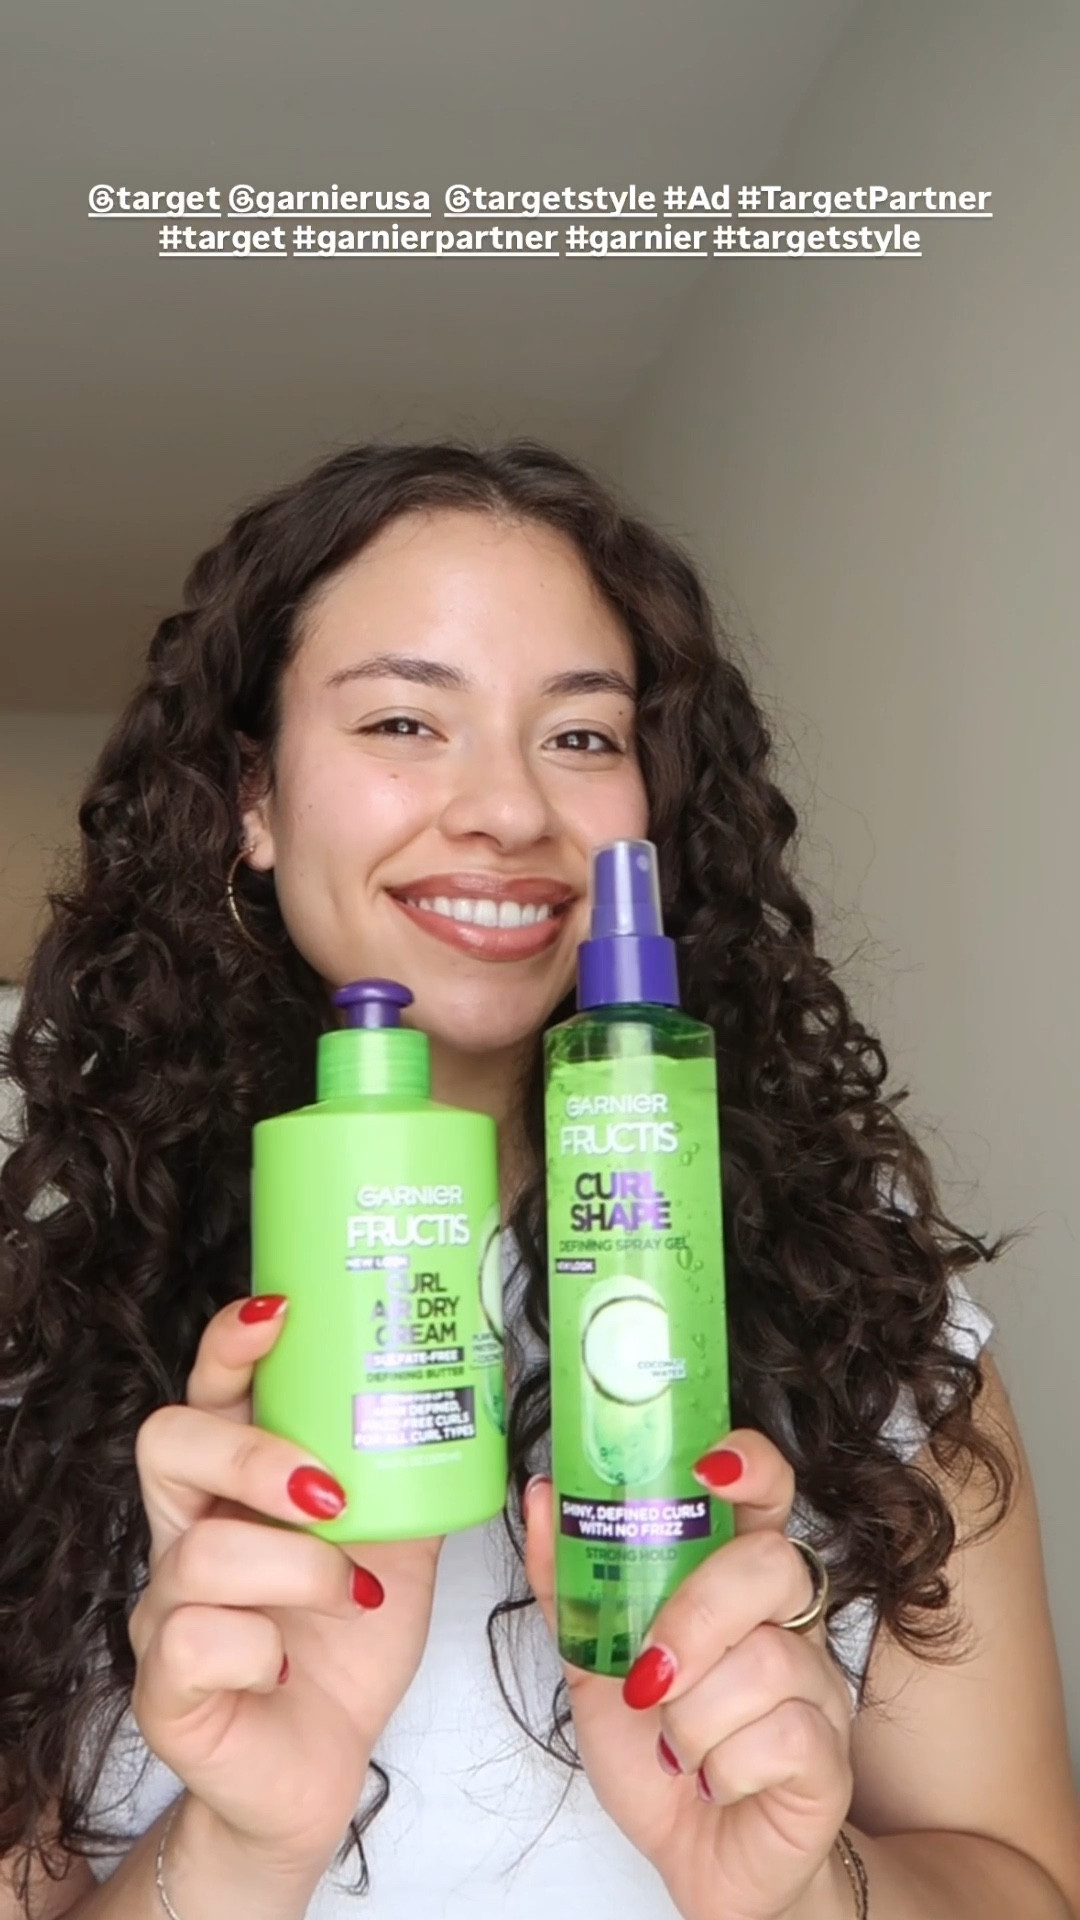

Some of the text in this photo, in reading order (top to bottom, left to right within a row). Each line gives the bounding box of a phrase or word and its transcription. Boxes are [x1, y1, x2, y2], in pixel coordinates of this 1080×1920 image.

[566, 1093, 668, 1117] GARNIER
[561, 1121, 678, 1155] FRUCTIS
[357, 1184, 463, 1210] GARNIER
[575, 1171, 664, 1201] CURL
[571, 1201, 671, 1232] SHAPE
[347, 1214, 470, 1248] FRUCTIS
[616, 1237, 660, 1251] SPRAY
[665, 1236, 688, 1250] GEL
[372, 1296, 460, 1321] AR DRY
[425, 1365, 465, 1381] BUTTER
[435, 1411, 470, 1427] CURLS
[411, 1428, 442, 1444] CURL
[443, 1423, 475, 1440] TYPES
[596, 1504, 659, 1523] DEFINED
[661, 1501, 706, 1521] CURLS
[579, 1519, 684, 1538] WITH NO FRIZZ
[585, 1546, 678, 1563] STRONG HOLD
